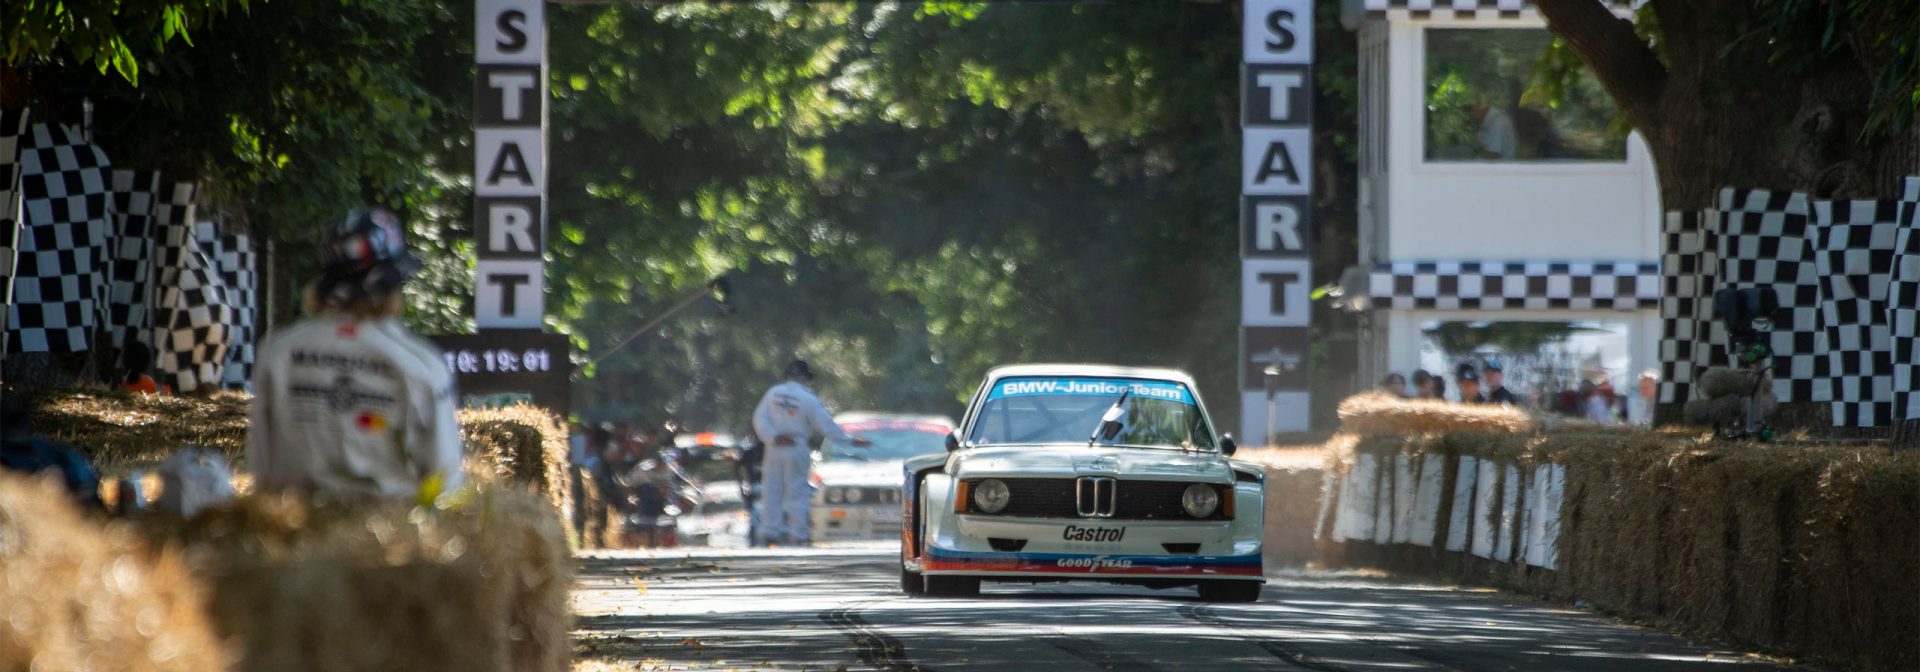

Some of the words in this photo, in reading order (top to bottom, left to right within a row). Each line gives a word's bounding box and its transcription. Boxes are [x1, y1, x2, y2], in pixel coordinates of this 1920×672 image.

[487, 10, 535, 317] START
[1254, 10, 1303, 316] START
[1063, 525, 1126, 542] Castrol
